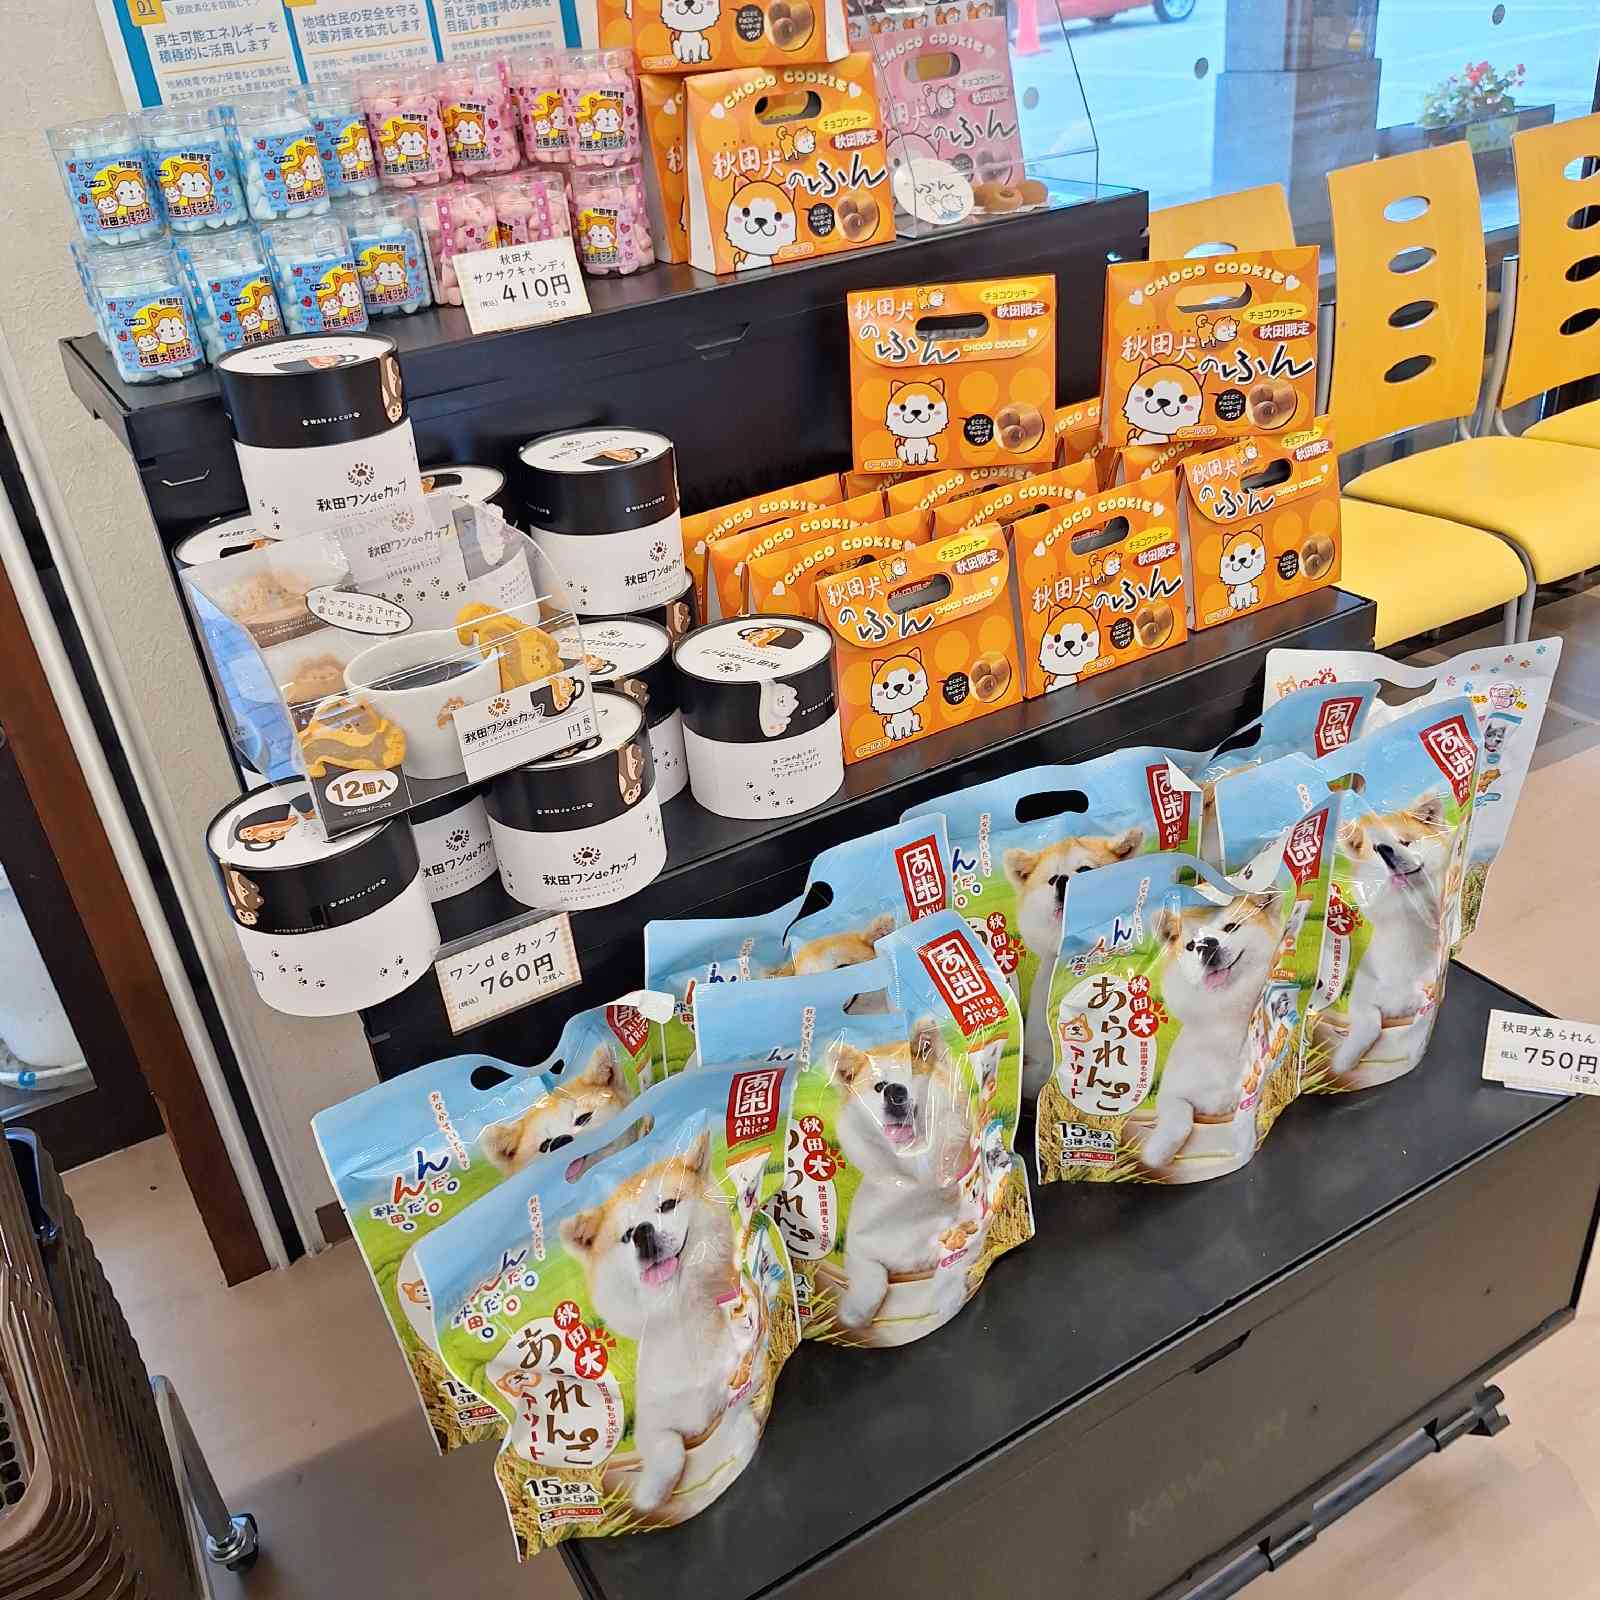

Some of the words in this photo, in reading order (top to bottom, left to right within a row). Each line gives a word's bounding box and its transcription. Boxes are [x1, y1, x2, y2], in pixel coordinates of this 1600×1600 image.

[302, 6, 419, 29] 地域住民の安全を守る
[305, 18, 422, 46] 災害対策を拡充します
[447, 15, 498, 32] 目指します
[155, 22, 279, 48] 再生可能エネルギーを
[159, 37, 270, 63] 積極的に活用します
[723, 73, 778, 109] CHOCO
[823, 115, 868, 130] チョコクッキー
[713, 146, 784, 180] 秋田犬
[787, 152, 888, 197] のふん
[473, 259, 566, 285] サクサクキャンディ
[500, 251, 533, 266] 秋田犬
[502, 273, 571, 303] 410円
[984, 288, 1036, 301] チョコクッキー
[1144, 264, 1206, 296] CHOCO
[855, 297, 915, 321] 秋田犬
[996, 302, 1046, 319] 秋田限定
[1247, 307, 1303, 320] チョコクッキー
[1259, 321, 1310, 339] 秋田限定
[875, 329, 960, 365] ふん
[1121, 332, 1198, 362] 秋田犬
[1199, 344, 1316, 385] のふん
[309, 417, 327, 425] WAN
[1192, 454, 1239, 485] 秋田犬
[316, 477, 408, 513] 秋田ワンdeカップ
[919, 473, 965, 510] CHOCO
[1214, 487, 1275, 520] ふん
[967, 491, 1014, 529] CHOCO
[367, 524, 450, 559] 秋田ワンdeカップ
[706, 508, 753, 544] CHOCO
[1045, 507, 1092, 545] CHOCO
[747, 527, 795, 562] CHOCO
[940, 538, 986, 560] チョコクッキー
[784, 544, 836, 586] CHOCO
[956, 549, 1001, 574] 秋田限定
[827, 576, 885, 607] 秋田犬
[1033, 577, 1091, 612] 秋田犬
[1094, 566, 1183, 613] のふん
[856, 609, 937, 641] ふん
[464, 704, 544, 744] 秋田ワンdeカップ
[567, 723, 581, 740] 円
[331, 778, 392, 803] 12個入
[543, 853, 638, 887] 秋田ワンdeカップ
[338, 895, 355, 904] WAN
[450, 927, 560, 982] ワンdeカップ
[988, 914, 1017, 972] 秋田犬
[480, 952, 554, 996] 760円
[962, 997, 994, 1016] Akita
[1130, 976, 1155, 1034] 秋田犬
[1086, 976, 1131, 1112] あられんこ
[1502, 1020, 1600, 1045] 秋田犬あられん
[1524, 1046, 1599, 1075] 750円
[735, 1116, 770, 1129] Akita
[1057, 1121, 1115, 1142] 15袋入
[802, 1118, 833, 1177] 秋田犬
[556, 1305, 603, 1377] 秋田犬
[517, 1327, 601, 1466] あれんこ
[525, 1478, 603, 1499] 15袋入
[538, 1492, 597, 1507] 3種×5袋
